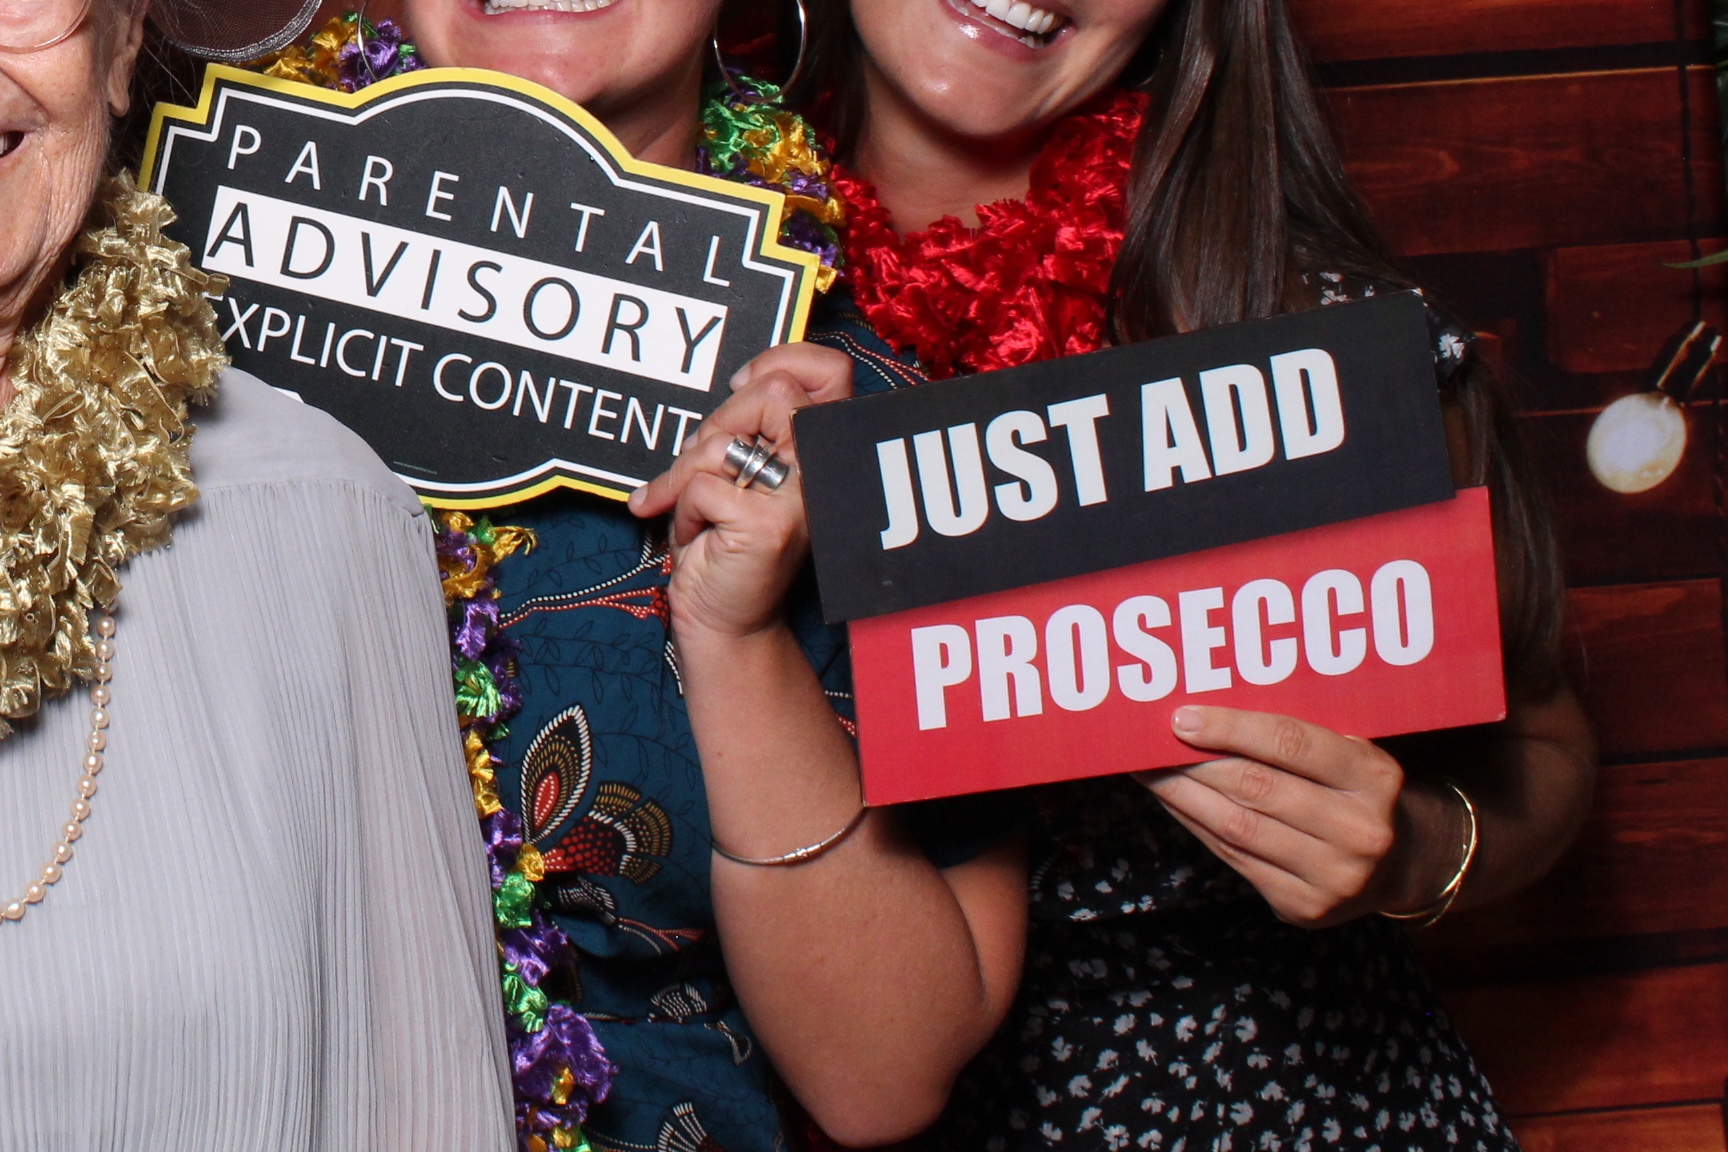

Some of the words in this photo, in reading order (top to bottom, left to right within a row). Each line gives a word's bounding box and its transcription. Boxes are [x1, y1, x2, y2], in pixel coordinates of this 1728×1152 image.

[206, 202, 722, 374] ADVISORY
[228, 125, 730, 287] PARENTAL
[204, 291, 424, 387] XPLICIT
[433, 353, 703, 457] CONTENT
[876, 393, 1109, 550] JUST
[1141, 348, 1345, 493] ADD
[910, 559, 1434, 731] PROSECCO
